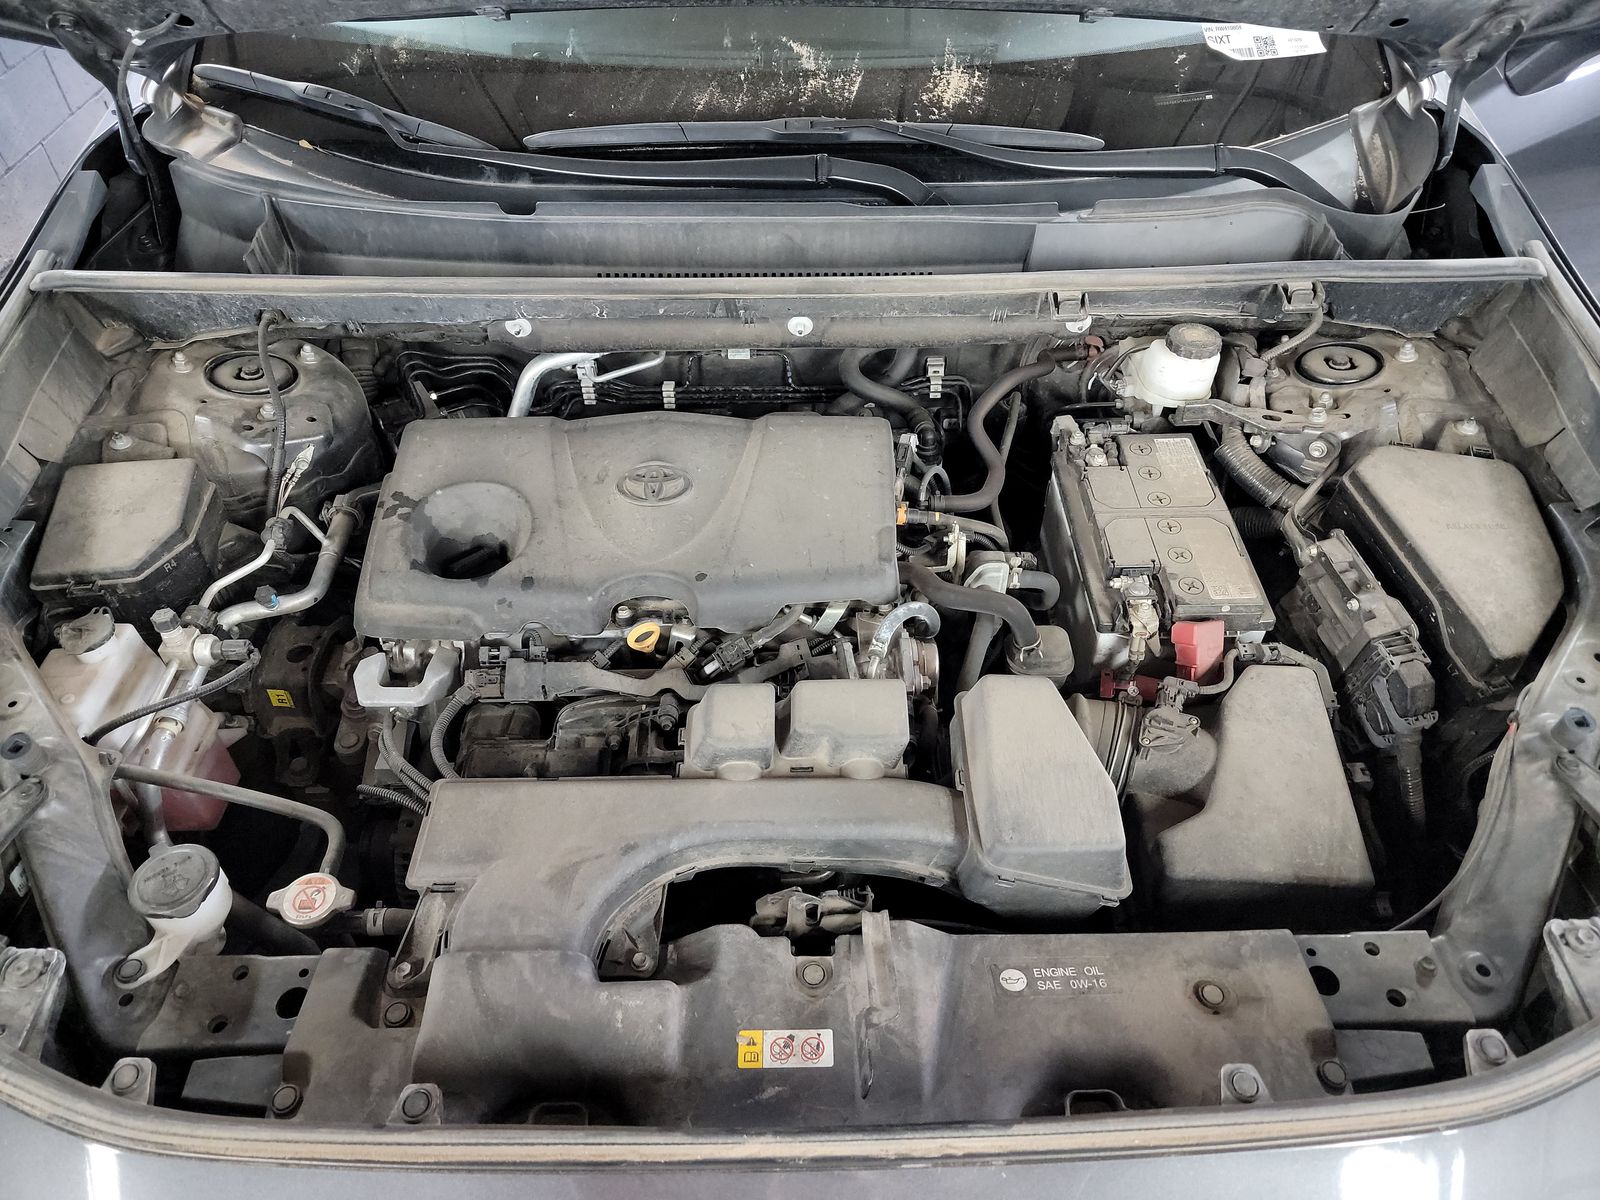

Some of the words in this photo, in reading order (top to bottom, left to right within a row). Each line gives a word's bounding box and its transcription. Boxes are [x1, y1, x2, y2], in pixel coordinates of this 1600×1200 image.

[1207, 34, 1231, 44] SIXT
[163, 559, 177, 573] R4
[1033, 966, 1077, 978] ENGINE
[1084, 966, 1104, 976] OIL
[1037, 980, 1062, 990] SAE
[1070, 978, 1108, 989] 0W-16
